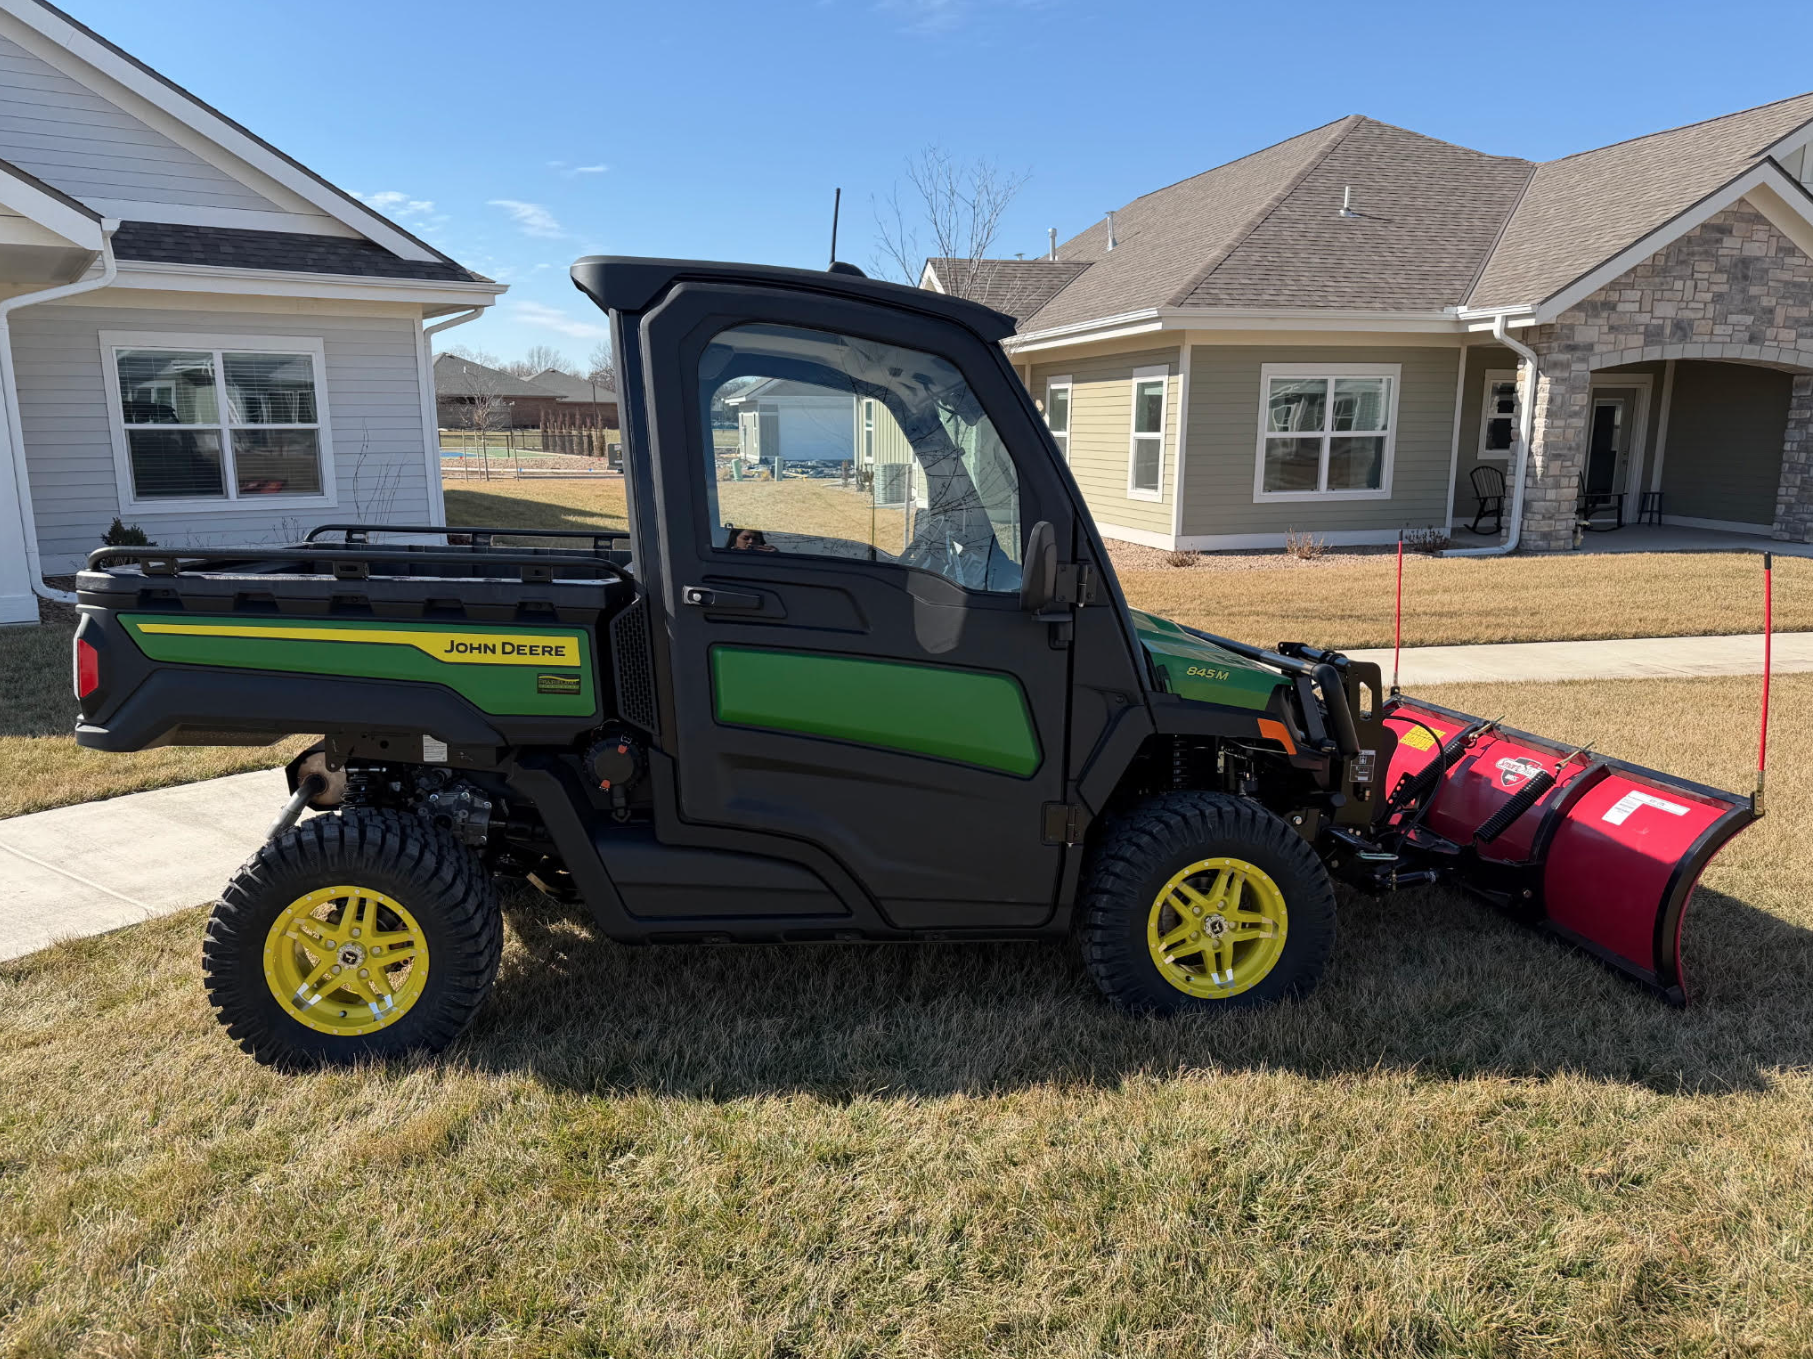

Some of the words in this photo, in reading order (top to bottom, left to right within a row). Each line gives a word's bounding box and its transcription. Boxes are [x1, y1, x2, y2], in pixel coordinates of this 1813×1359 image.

[444, 640, 496, 655] JOHN
[501, 641, 566, 657] DEERE
[1186, 666, 1230, 681] 845M
